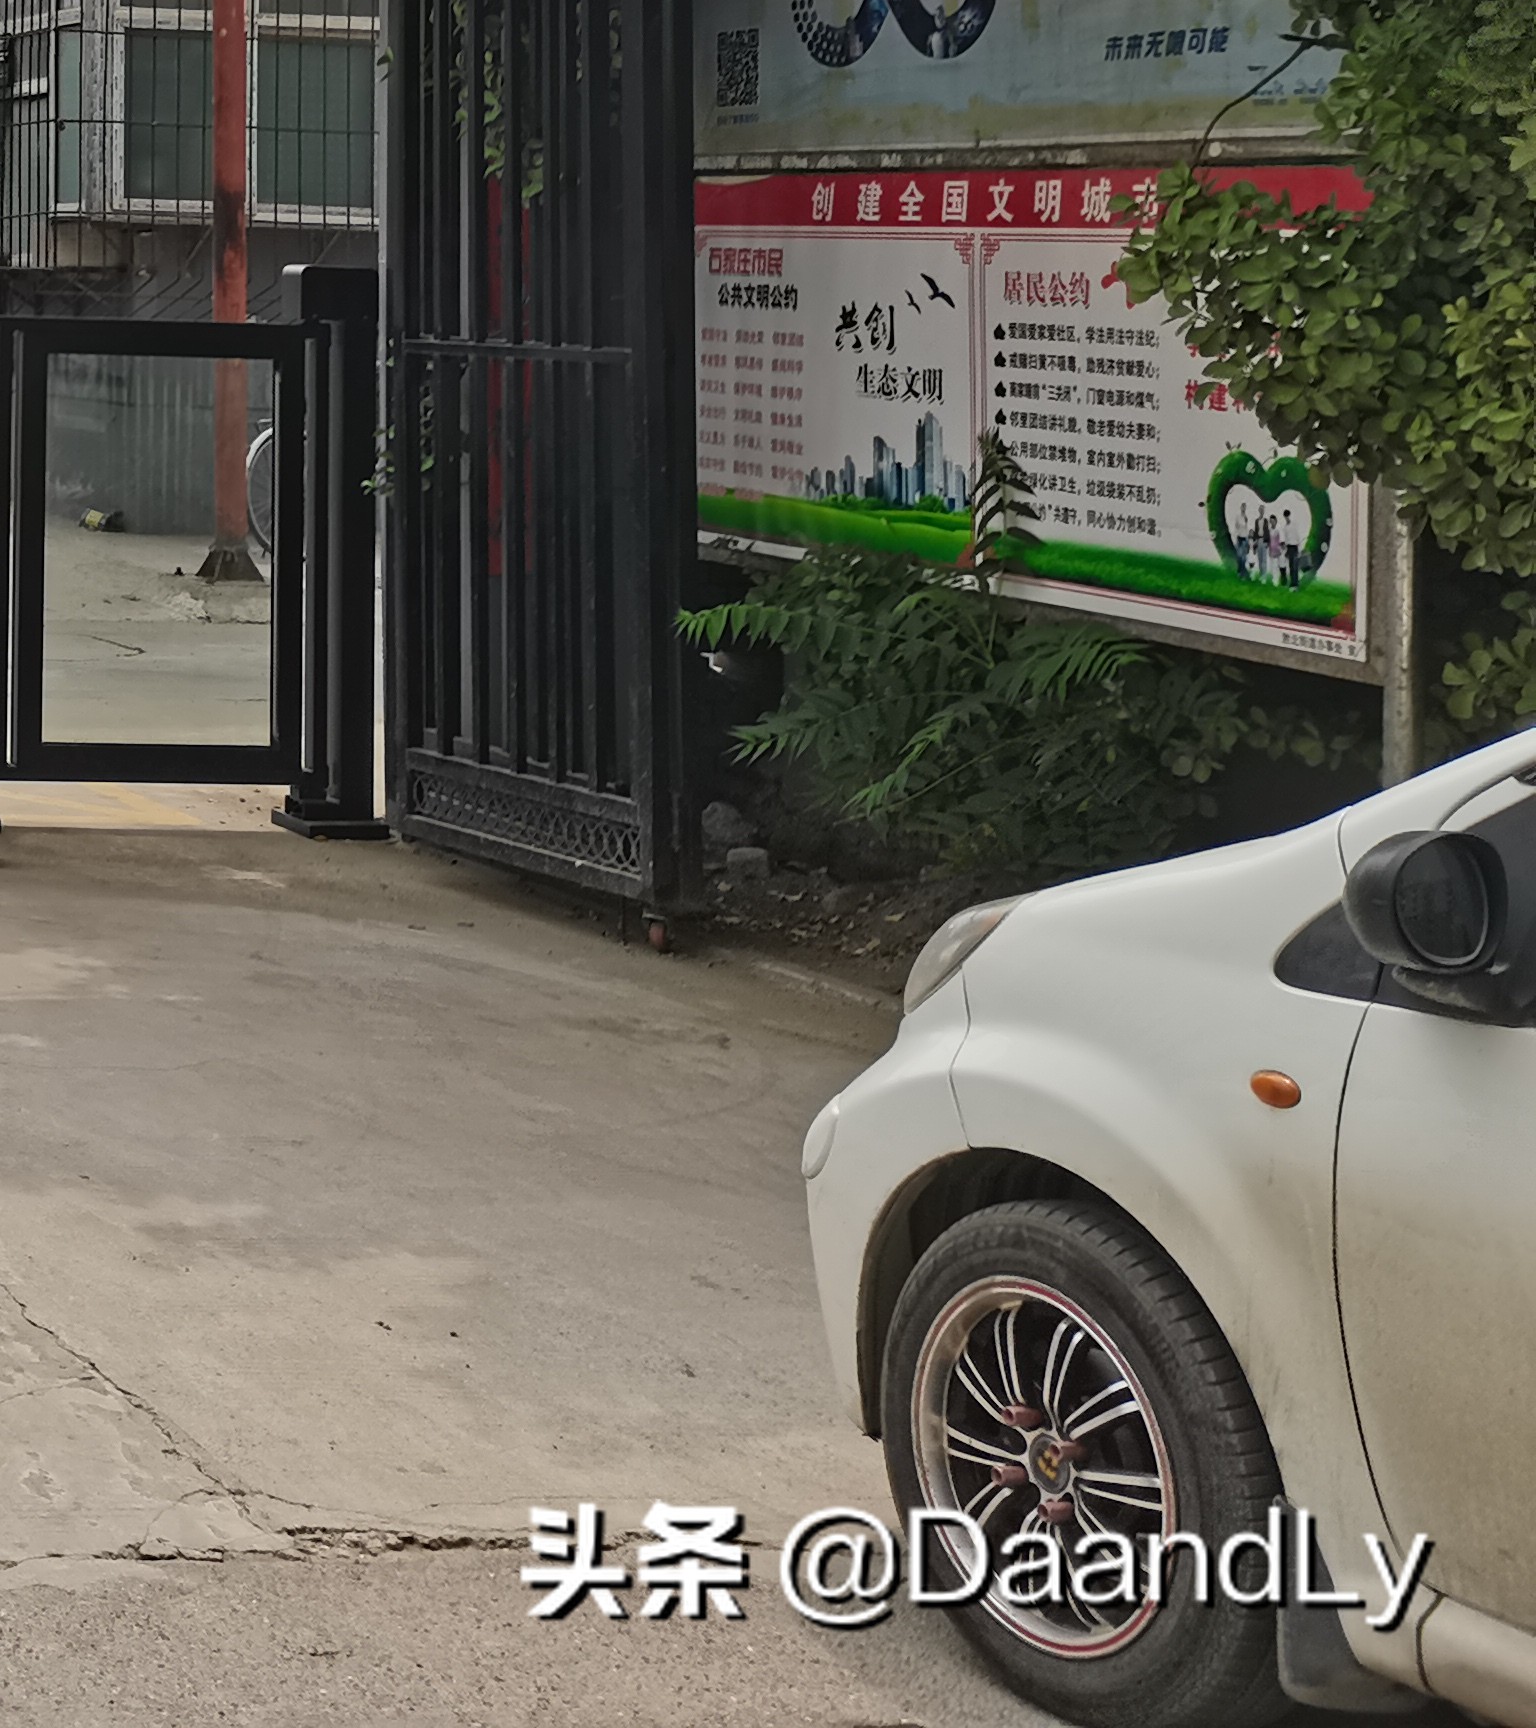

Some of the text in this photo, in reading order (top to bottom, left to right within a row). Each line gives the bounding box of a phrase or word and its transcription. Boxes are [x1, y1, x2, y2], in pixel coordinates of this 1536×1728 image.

[1104, 26, 1230, 62] 未来无限可能
[811, 177, 1159, 224] 创建全国文明城市
[709, 247, 784, 276] 石家庄市民
[717, 282, 798, 311] 公共文明公约
[1003, 270, 1091, 308] 居民公约
[835, 300, 896, 353] 共创
[855, 363, 943, 403] 生态文明
